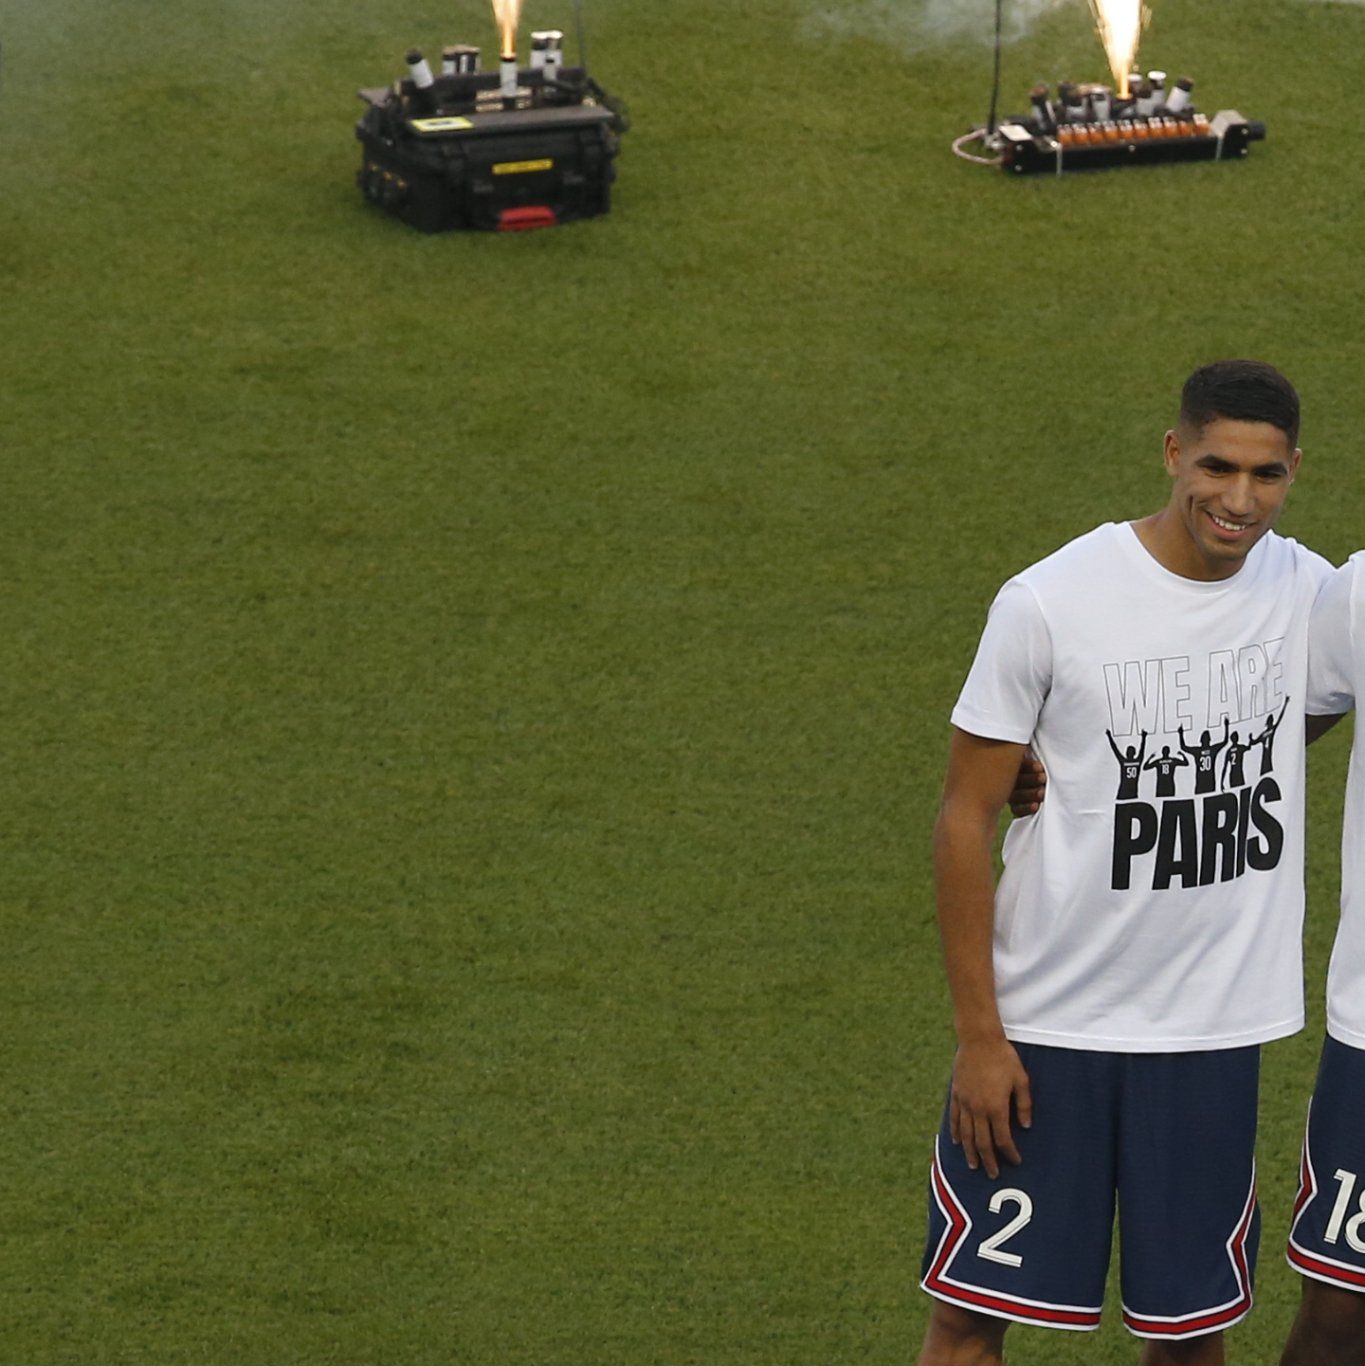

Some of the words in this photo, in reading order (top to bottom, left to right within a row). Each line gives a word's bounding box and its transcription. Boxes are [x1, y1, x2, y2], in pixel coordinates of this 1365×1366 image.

[1103, 655, 1193, 737] WE
[1207, 637, 1285, 728] ARE
[1126, 767, 1137, 778] 50
[1200, 756, 1211, 771] 30
[1230, 753, 1237, 765] 2
[1111, 777, 1284, 890] PARIS
[976, 1187, 1033, 1268] 2
